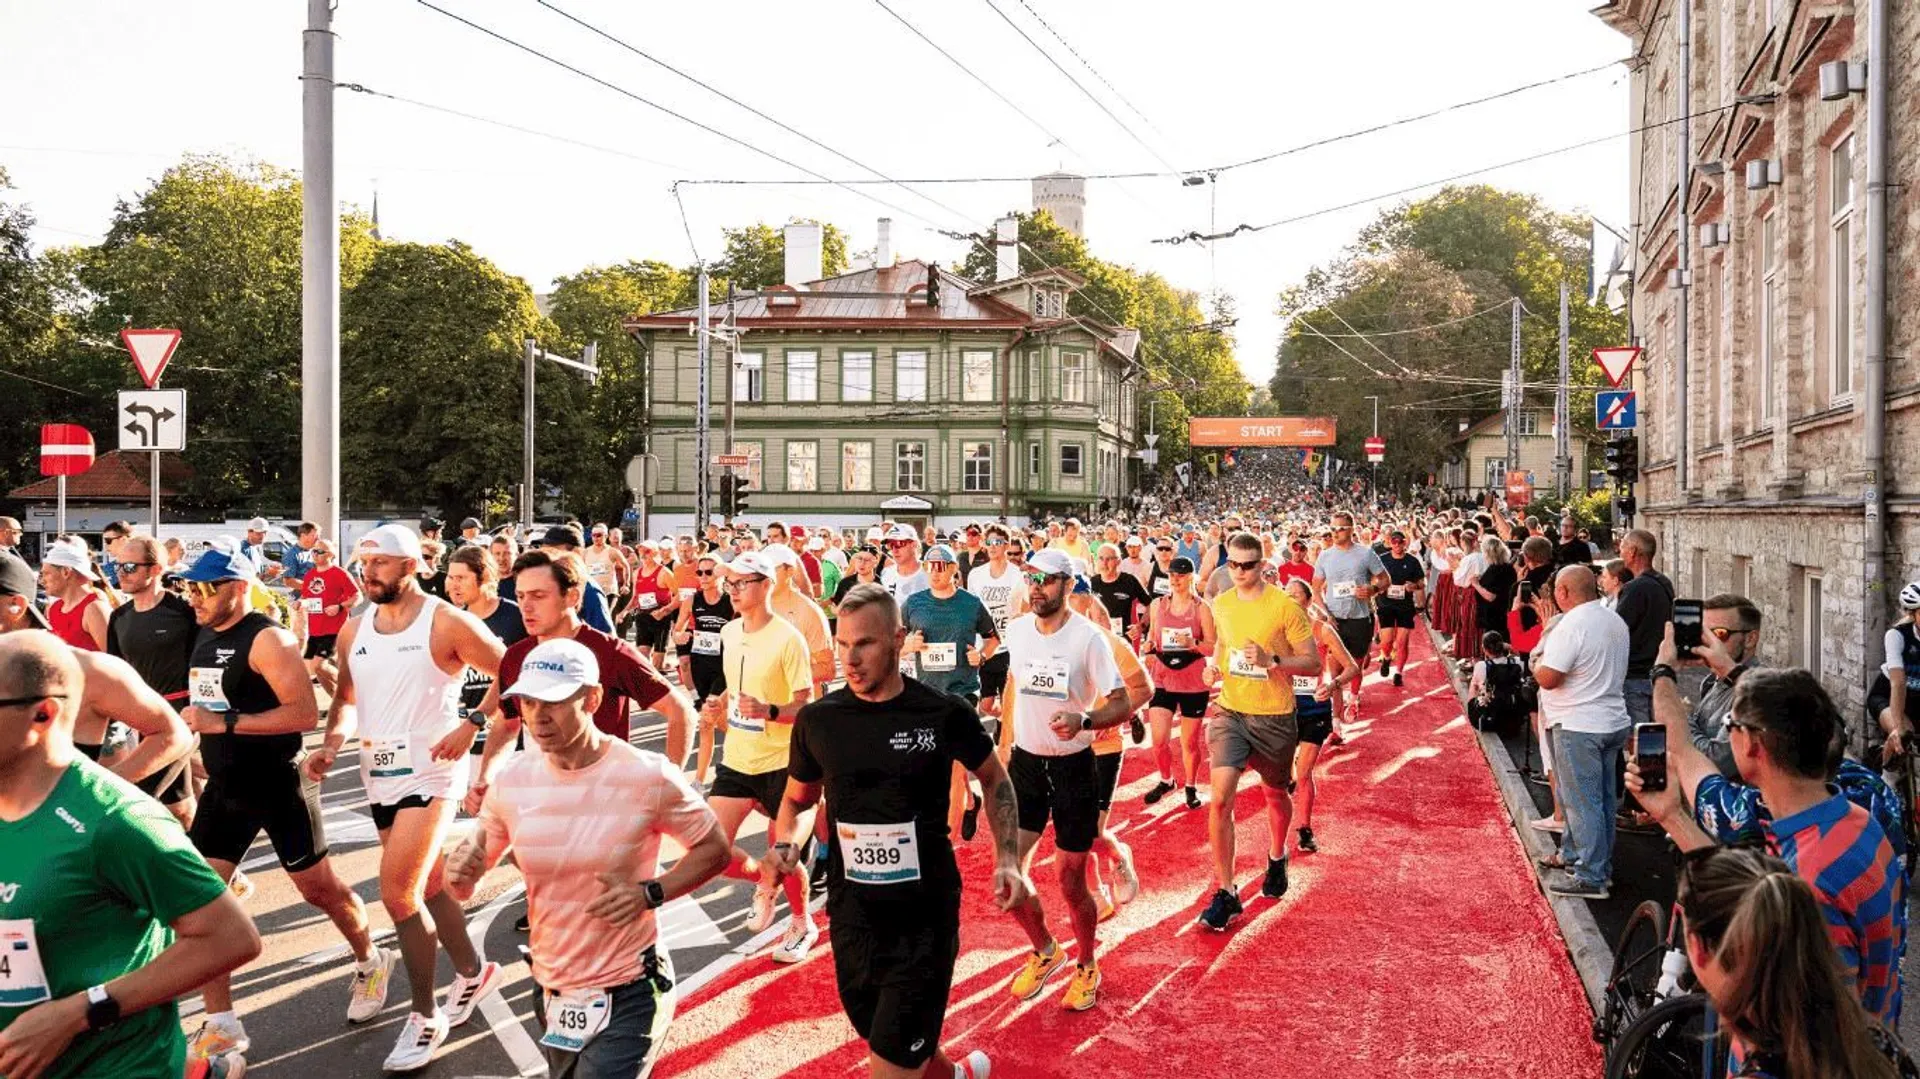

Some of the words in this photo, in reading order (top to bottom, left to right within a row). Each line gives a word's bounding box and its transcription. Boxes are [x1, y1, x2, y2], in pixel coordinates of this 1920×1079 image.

[1240, 425, 1284, 437] START
[1032, 675, 1054, 688] 250
[374, 752, 396, 766] 587
[853, 848, 901, 865] 3389
[559, 1010, 587, 1030] 439
